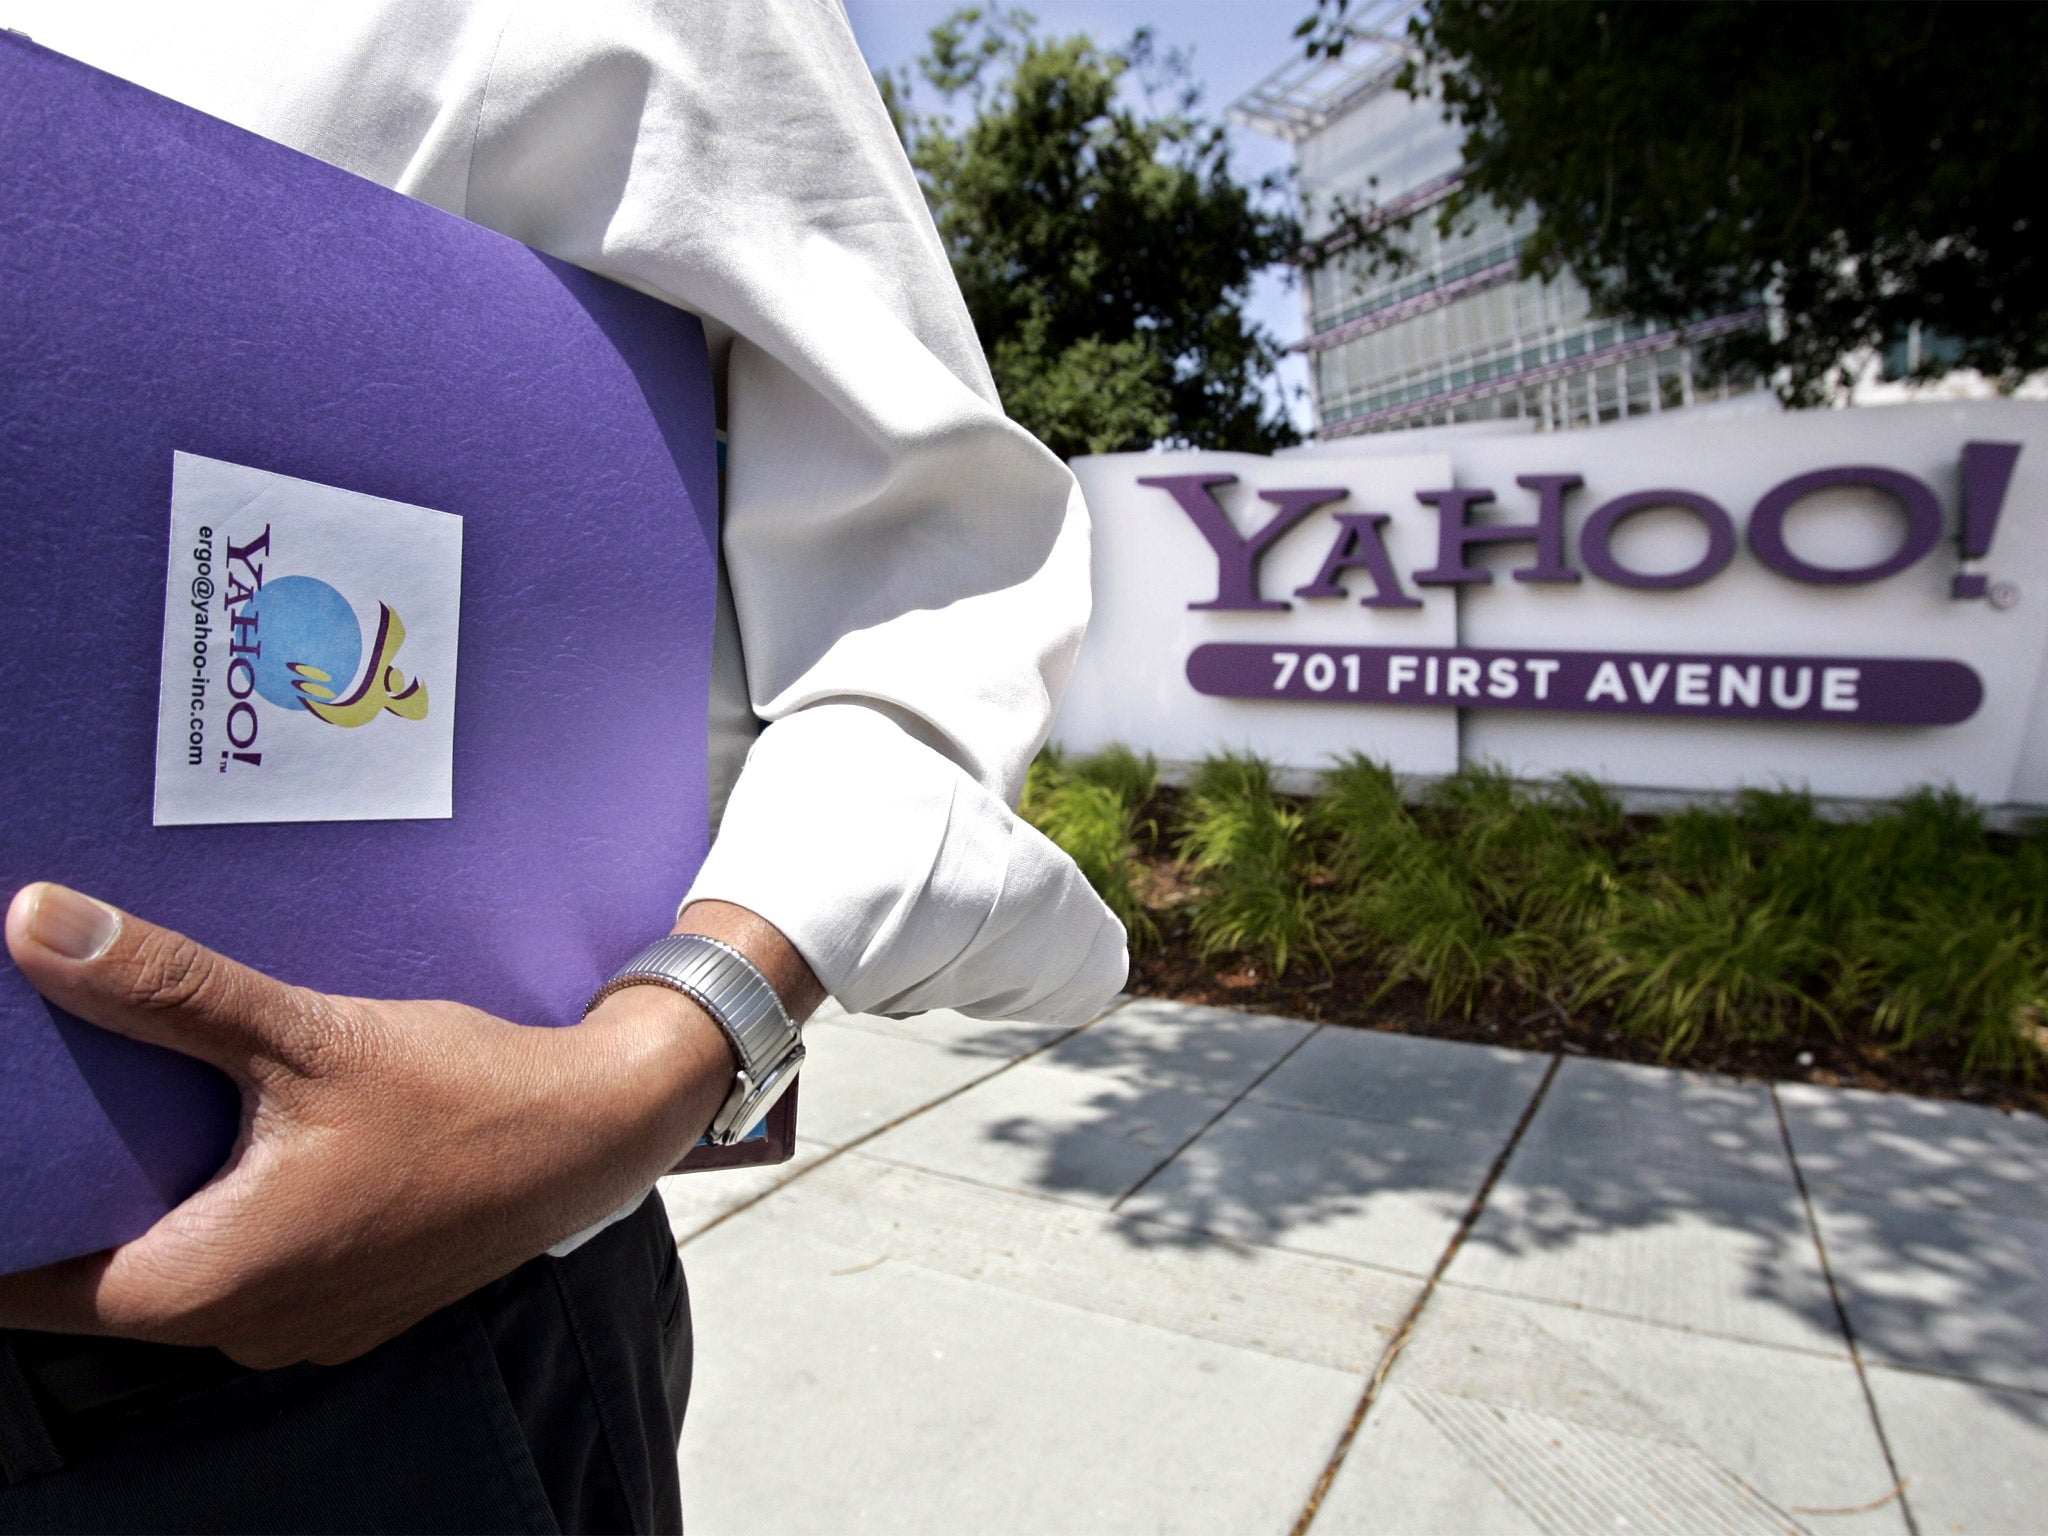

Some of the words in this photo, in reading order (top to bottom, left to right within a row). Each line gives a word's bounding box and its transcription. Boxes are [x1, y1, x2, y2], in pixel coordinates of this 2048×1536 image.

[1137, 441, 2023, 611] YAHOO!
[188, 526, 215, 766] ergo@yahoo-inc.com
[221, 523, 270, 767] YAHOO!
[1272, 652, 1360, 693] 701
[1387, 655, 1560, 700] FIRST
[1585, 660, 1861, 711] AVENUE
